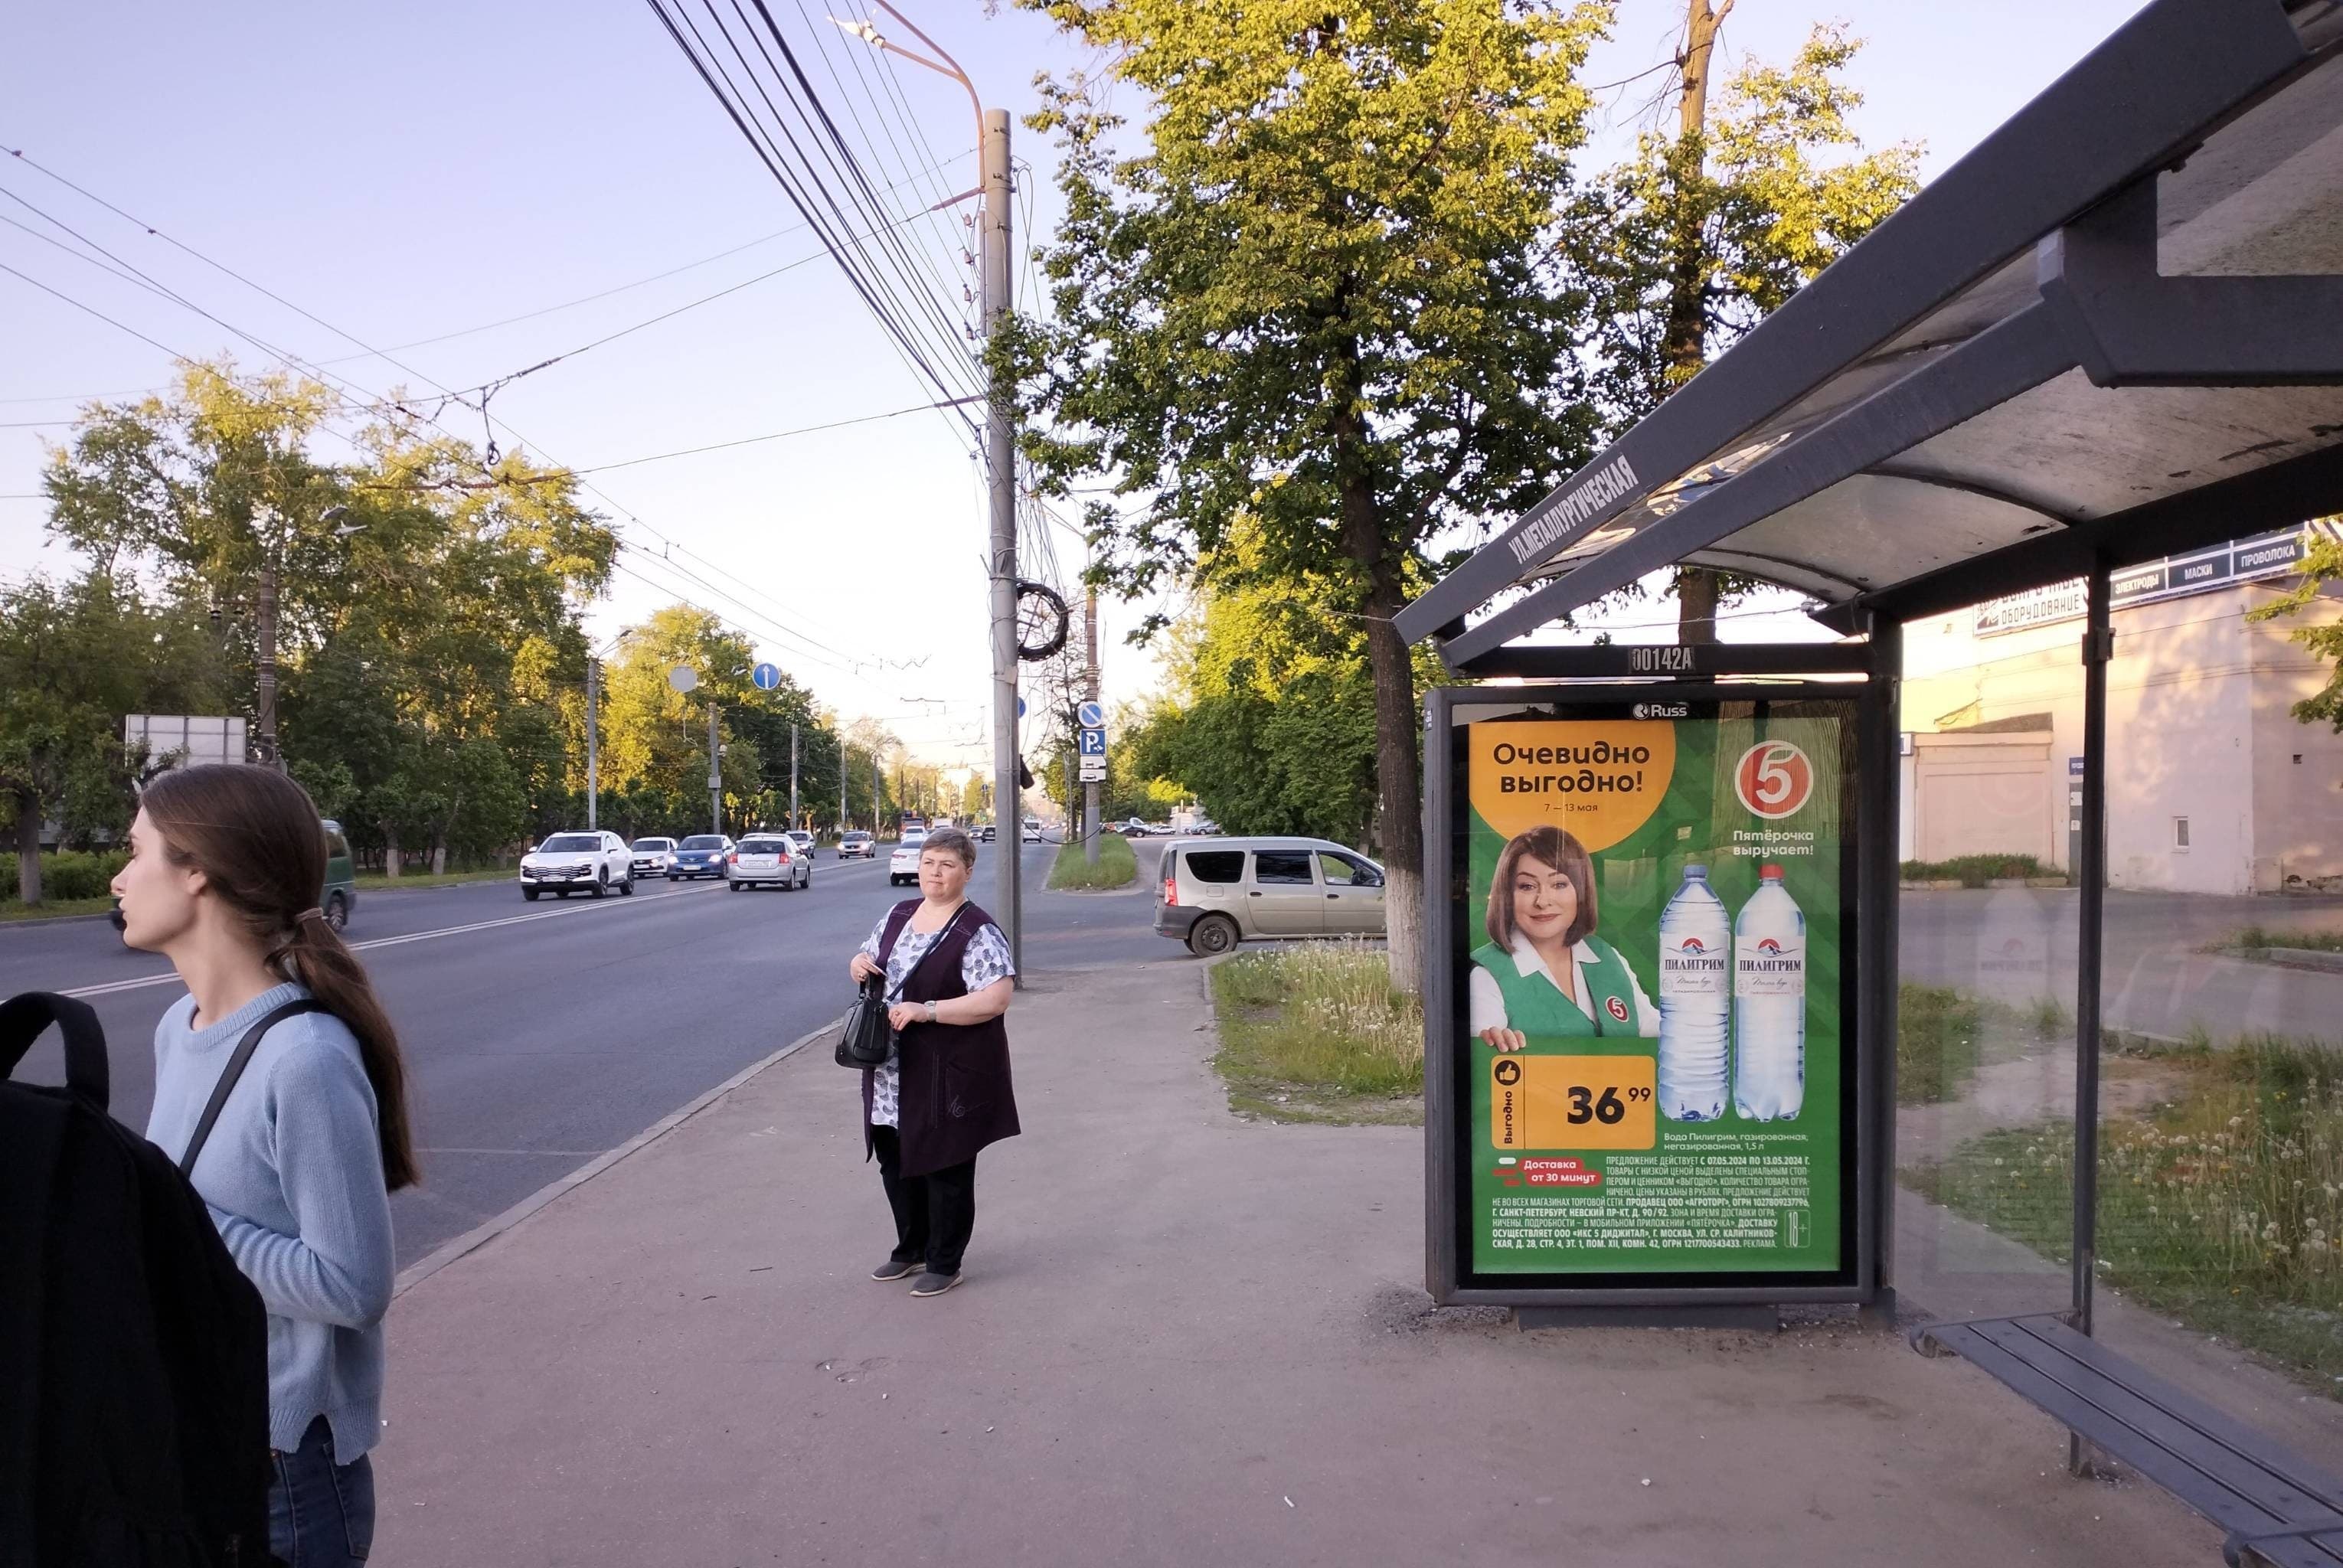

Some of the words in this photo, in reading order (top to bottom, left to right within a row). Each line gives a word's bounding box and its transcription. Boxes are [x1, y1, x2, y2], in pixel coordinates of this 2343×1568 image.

[2241, 544, 2296, 567] ПРОВОЛОКА
[2185, 564, 2213, 580] МАСКИ
[2115, 574, 2159, 594] ЭЛЕКТРОДЫ
[2002, 594, 2080, 625] ОБОРУДОВАНИЕ
[1651, 704, 1688, 717] Russ
[1493, 740, 1650, 764] Очевидно
[1501, 769, 1642, 793] выгодно!
[1733, 829, 1814, 843] Пятёрочка
[1733, 845, 1814, 858] выручает!
[1665, 959, 1724, 970] ПИЛИГРИМ
[1740, 960, 1802, 971] ПИЛИГРИМ
[1628, 1087, 1651, 1102] 99
[1567, 1086, 1625, 1125] 36
[1503, 1090, 1513, 1144] Выгодно
[1664, 1133, 1688, 1142] Вода
[1689, 1133, 1737, 1142] Пилигрим,
[1740, 1134, 1809, 1142] газированная,
[1664, 1143, 1743, 1152] негазированная,
[1745, 1142, 1756, 1151] 1,5
[1524, 1160, 1577, 1170] Доставка
[1606, 1156, 1658, 1165] ПРЕДЛОЖЕНИЕ
[1660, 1155, 1698, 1165] ДЕЙСТВУЕТ
[1700, 1156, 1705, 1165] С
[1707, 1156, 1747, 1165] 07.05.2024
[1749, 1156, 1760, 1165] ПО
[1763, 1156, 1802, 1165] 13.05.2024
[1606, 1167, 1634, 1175] ТОВАРЫ
[1635, 1167, 1639, 1175] С
[1641, 1165, 1668, 1175] НИЗКОЙ
[1670, 1165, 1694, 1176] ЦЕНОЙ
[1695, 1167, 1734, 1176] ВЫДЕЛЕНЫ
[1735, 1167, 1788, 1176] СПЕЦИАЛЬНЫМ
[1789, 1167, 1809, 1175] СТОП-
[1560, 1174, 1596, 1184] минут
[1492, 1197, 1501, 1206] НЕ
[1502, 1197, 1511, 1206] ВО
[1512, 1197, 1529, 1206] ВСЕХ
[1530, 1197, 1570, 1206] МАГАЗИНАХ
[1571, 1196, 1605, 1206] ТОРГОВОЙ
[1626, 1197, 1666, 1207] ПРОДАВЕЦ
[1668, 1197, 1683, 1206] ООО
[1732, 1197, 1751, 1206] ОГРН
[1570, 1207, 1604, 1217] НЕВСКИЙ
[1632, 1209, 1640, 1217] Д.
[1720, 1209, 1756, 1217] ДОСТАВКИ
[1524, 1219, 1575, 1228] ПОДРОБНОСТИ
[1737, 1219, 1778, 1228] ДОСТАВКУ
[1788, 1211, 1808, 1247] 18+
[1492, 1229, 1553, 1238] ОСУЩЕСТВЛЯЕТ
[1554, 1229, 1570, 1237] ООО
[1573, 1229, 1592, 1237] «ИКС
[1594, 1229, 1600, 1237] 5
[1660, 1229, 1694, 1238] МОСКВА,
[1696, 1229, 1708, 1237] УЛ.
[1710, 1229, 1721, 1237] СР.
[1723, 1229, 1777, 1237] КАЛИТНИКОВ-
[1492, 1240, 1514, 1249] СКАЯ,
[1515, 1240, 1524, 1249] Д.
[1539, 1240, 1555, 1248] СТР.
[1557, 1240, 1564, 1249] 4,
[1565, 1240, 1577, 1248] ЭТ.
[1578, 1240, 1584, 1249] 1,
[1587, 1240, 1606, 1248] ПОМ.
[1622, 1240, 1647, 1248] КОМН.
[1649, 1240, 1660, 1249] 42,
[1662, 1240, 1681, 1248] ОГРН
